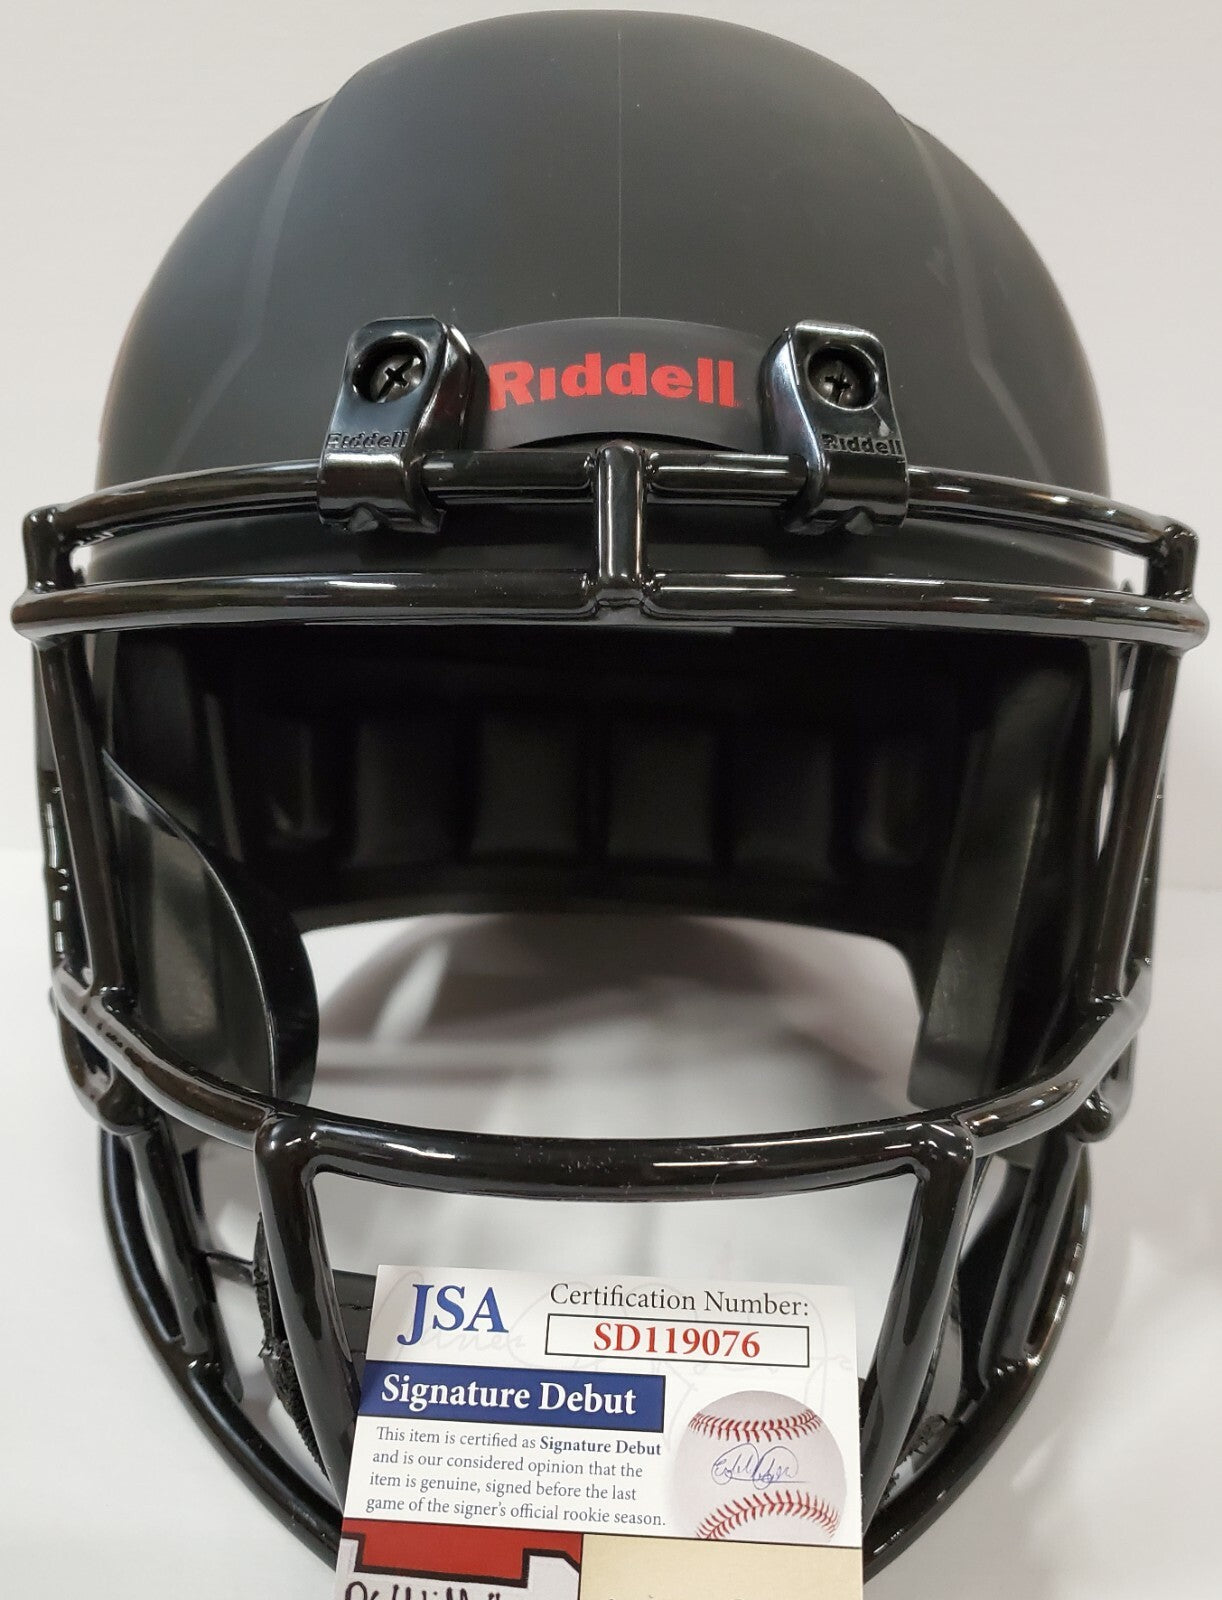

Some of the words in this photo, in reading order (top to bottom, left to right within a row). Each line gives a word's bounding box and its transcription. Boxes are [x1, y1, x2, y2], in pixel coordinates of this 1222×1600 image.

[489, 353, 735, 411] Riddell
[326, 430, 408, 449] Riddell
[821, 433, 903, 455] Riddell
[550, 1283, 695, 1311] Certification
[704, 1290, 809, 1316] Number:
[397, 1284, 509, 1345] JSA
[594, 1322, 761, 1358] SD119076
[381, 1374, 530, 1412] Signature
[538, 1382, 637, 1415] Debut
[376, 1426, 405, 1441] This
[409, 1428, 440, 1444] item
[445, 1431, 455, 1444] is
[460, 1433, 518, 1448] certified
[522, 1438, 535, 1449] as
[540, 1435, 611, 1454] Signature
[615, 1440, 661, 1455] Debut
[373, 1450, 398, 1463] and
[403, 1451, 414, 1464] is
[418, 1455, 443, 1466] our
[447, 1455, 523, 1471] considered
[528, 1459, 584, 1476] opinion
[589, 1461, 616, 1476] that
[621, 1463, 643, 1477] the
[369, 1472, 401, 1487] item
[406, 1474, 416, 1488] is
[420, 1477, 481, 1493] genuine,
[485, 1479, 531, 1497] signed
[536, 1481, 581, 1497] before
[586, 1484, 608, 1499] the
[612, 1485, 636, 1501] last
[366, 1498, 404, 1513] game
[409, 1497, 426, 1512] of
[428, 1498, 450, 1513] the
[454, 1500, 506, 1519] signer's
[510, 1503, 558, 1520] official
[563, 1507, 610, 1523] rookie
[614, 1513, 666, 1526] season.
